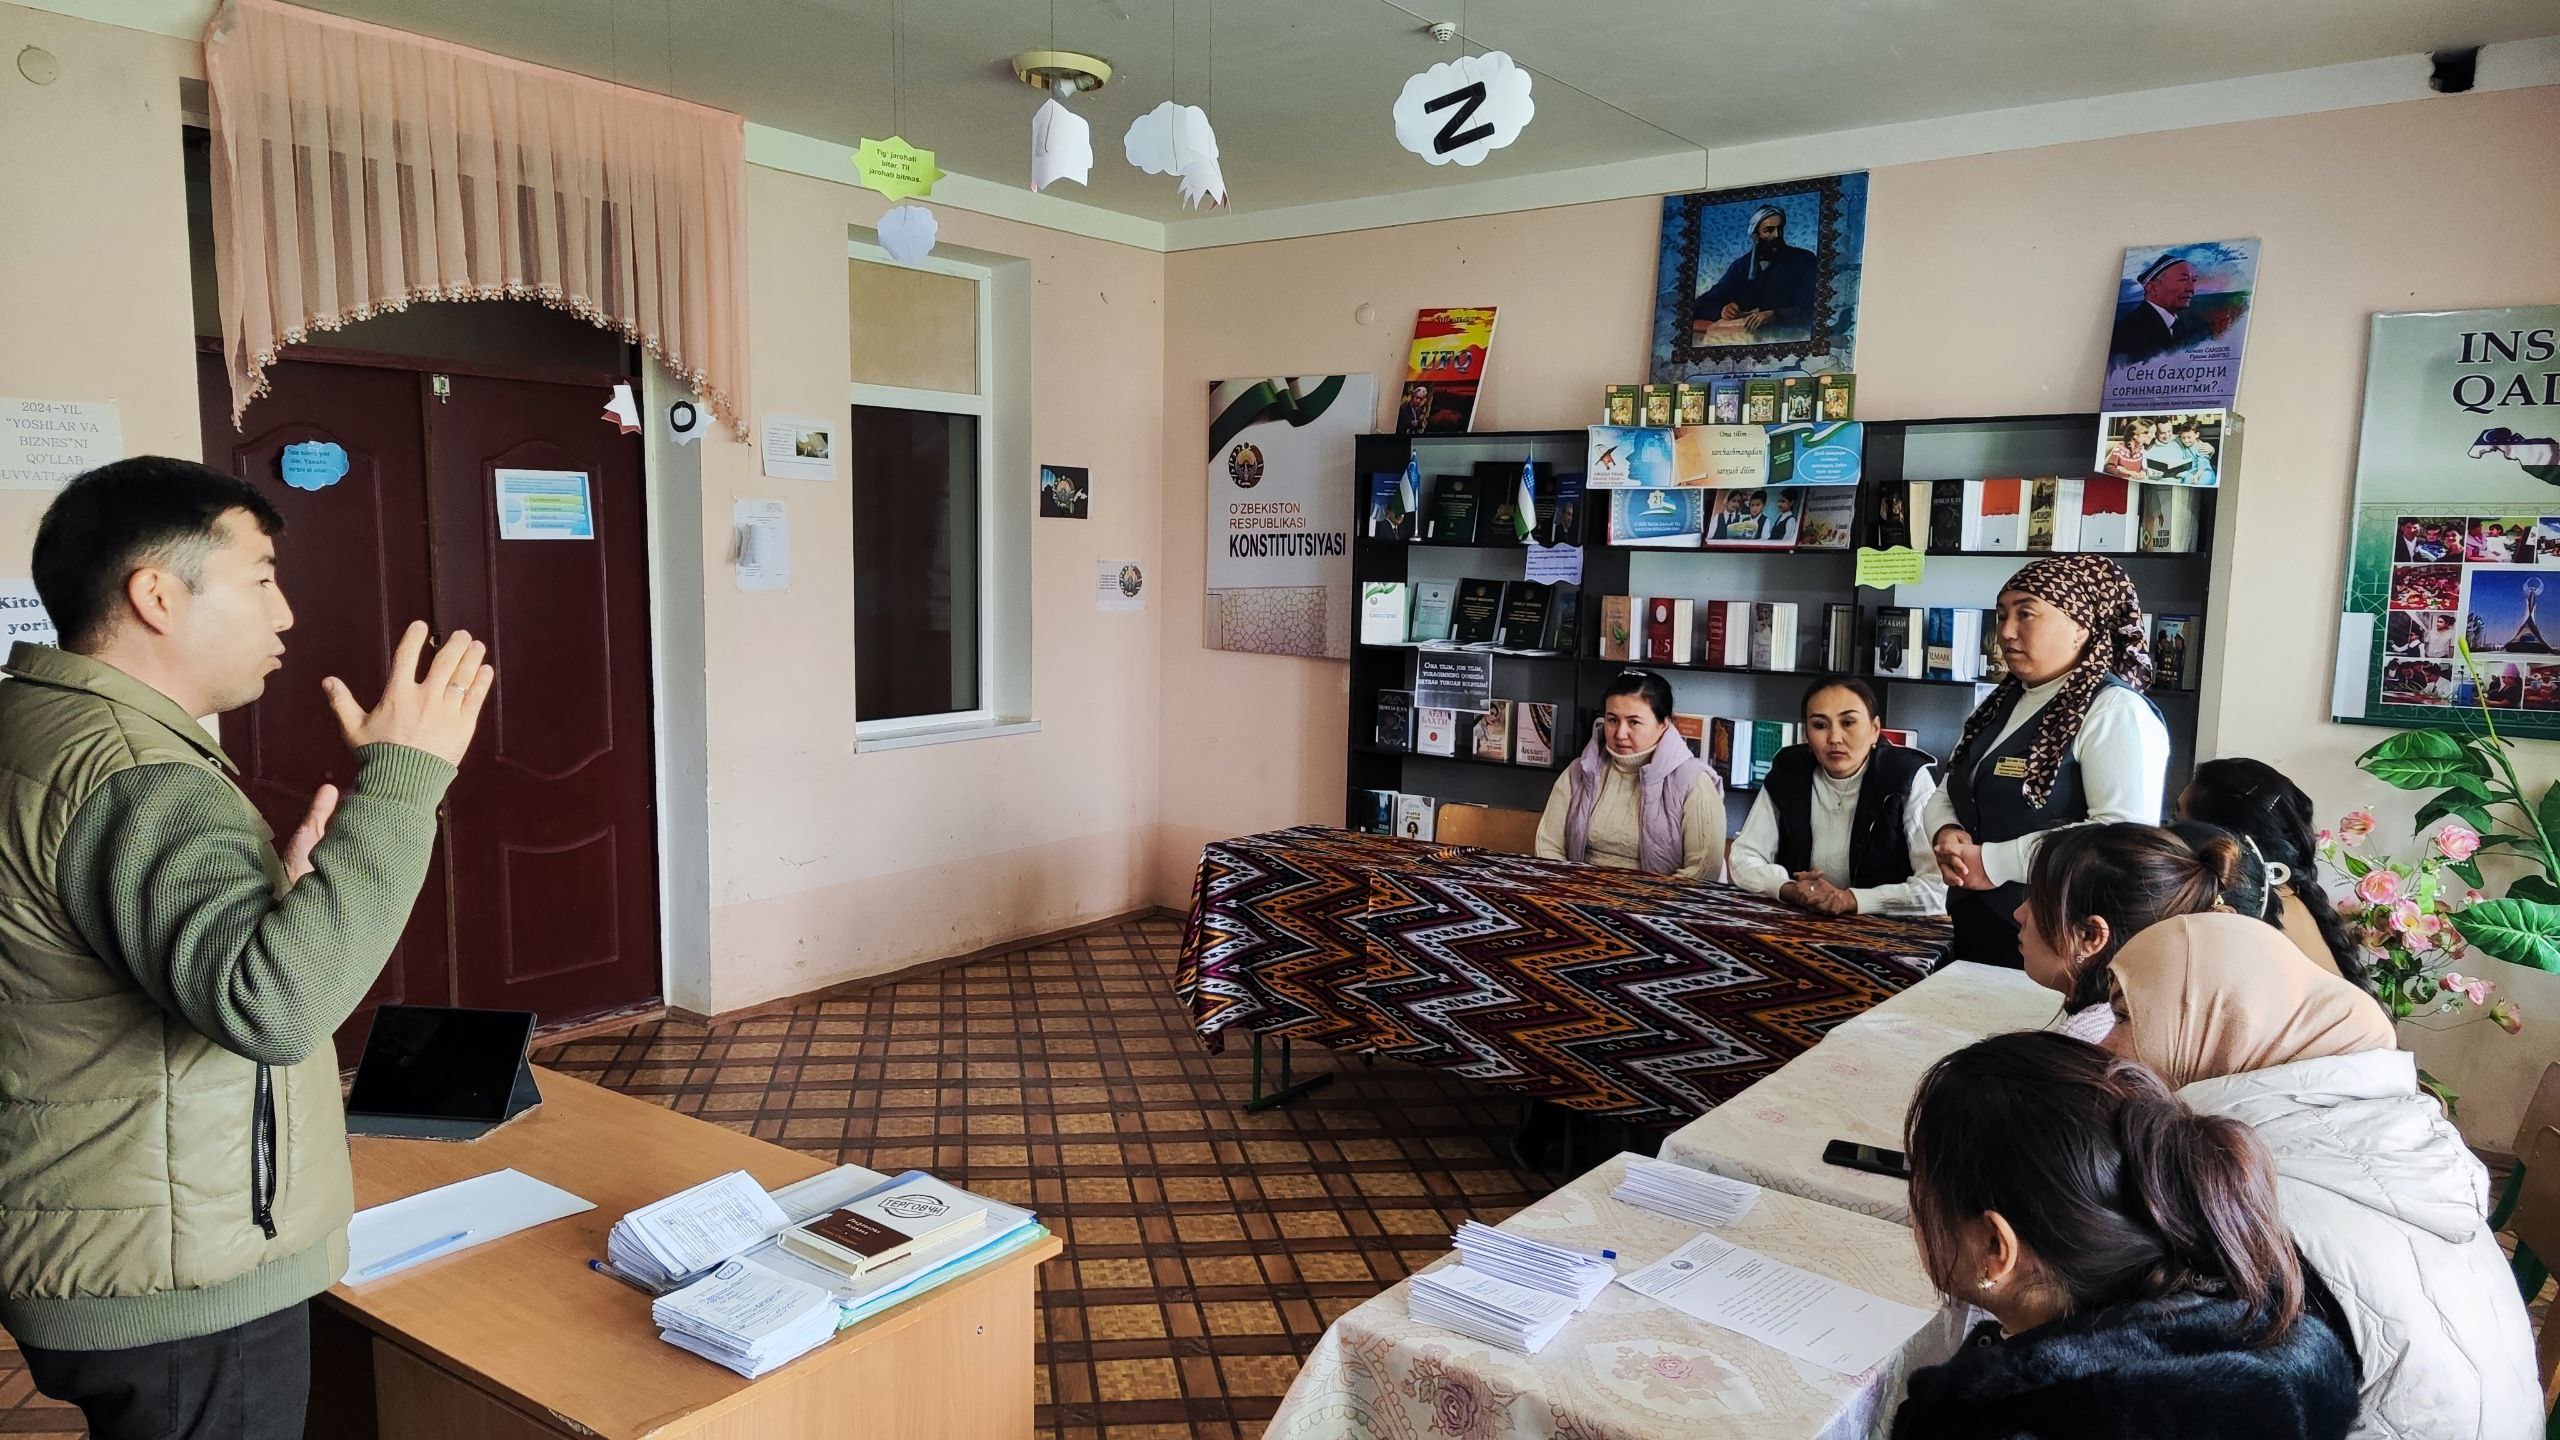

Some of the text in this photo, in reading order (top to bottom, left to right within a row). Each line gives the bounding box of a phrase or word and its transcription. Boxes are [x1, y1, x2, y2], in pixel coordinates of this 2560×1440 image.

[890, 152, 917, 163] jarohati
[901, 163, 910, 171] Til
[868, 168, 922, 183] jarohati bitmas.
[2457, 329, 2560, 364] INS
[2126, 364, 2228, 383] Сен баҳорни
[670, 401, 697, 432] O
[80, 422, 99, 432] VA
[26, 453, 84, 465] QO'LLAB
[1740, 466, 1755, 474] dilim
[1653, 495, 1662, 503] 21
[1229, 502, 1300, 515] O'ZBEKISTON
[1229, 517, 1306, 529] RESPUBLIKASI
[1229, 532, 1346, 557] KONSTITUTSIYASI
[0, 597, 42, 609] Kito
[8, 618, 56, 635] yori
